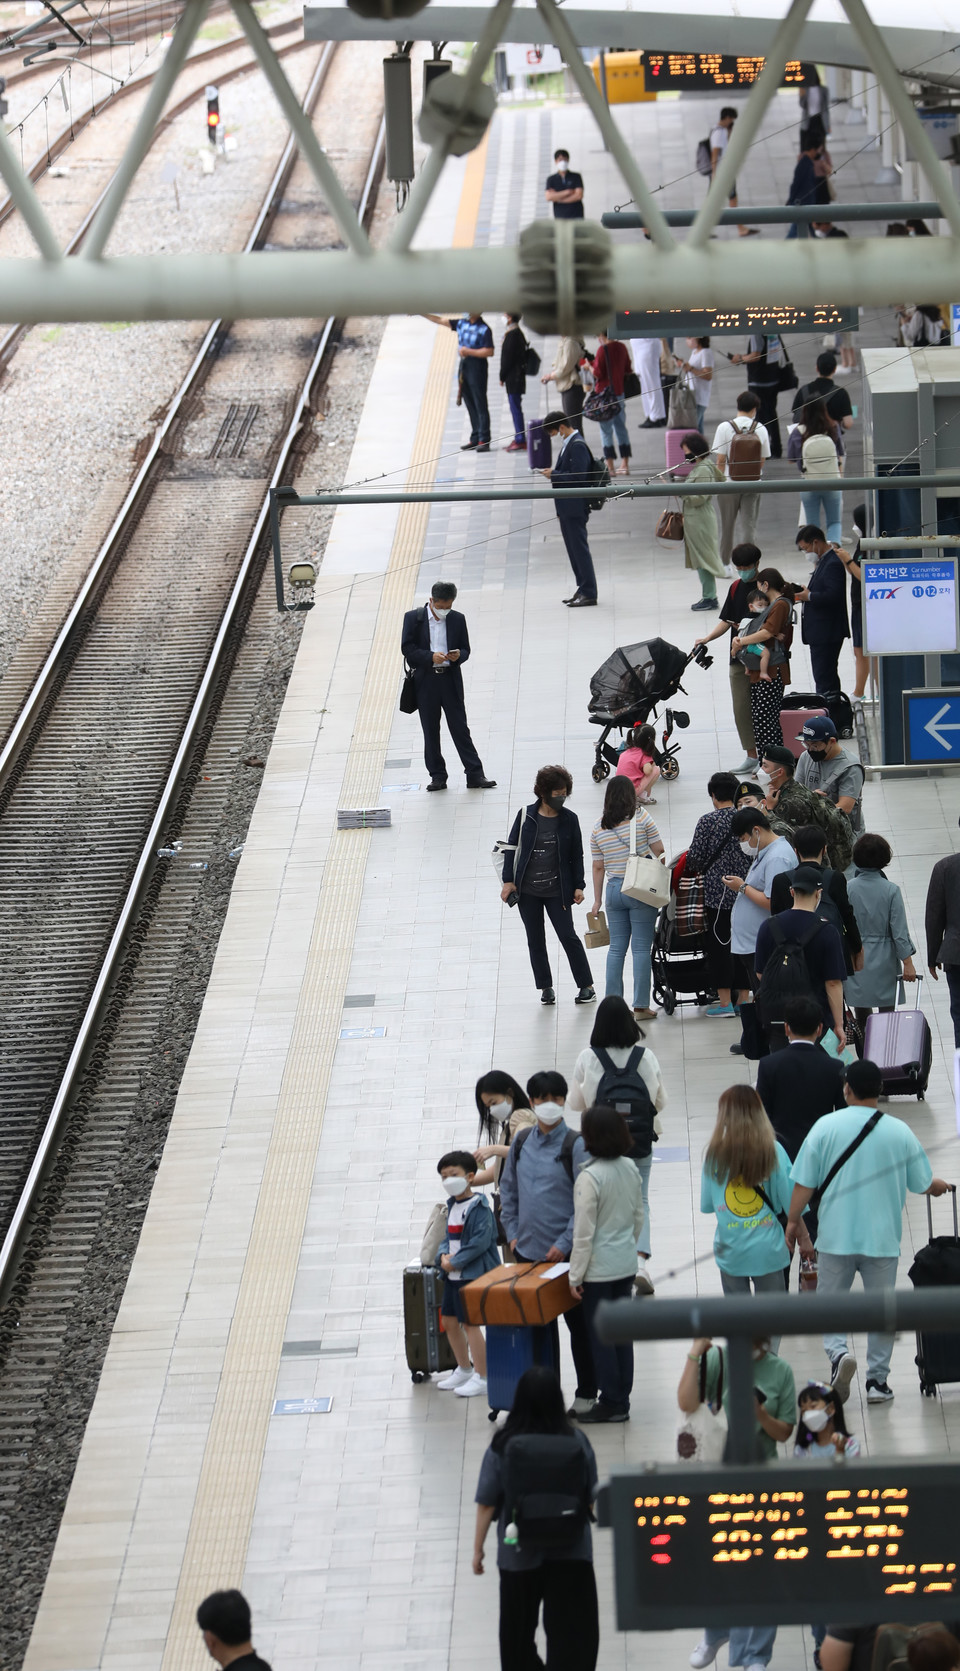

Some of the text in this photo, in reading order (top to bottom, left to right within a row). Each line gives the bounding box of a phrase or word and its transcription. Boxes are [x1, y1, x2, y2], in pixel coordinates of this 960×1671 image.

[868, 567, 908, 579] 호차번호
[869, 587, 902, 599] KTX
[913, 587, 923, 596] 11
[926, 587, 937, 596] 12
